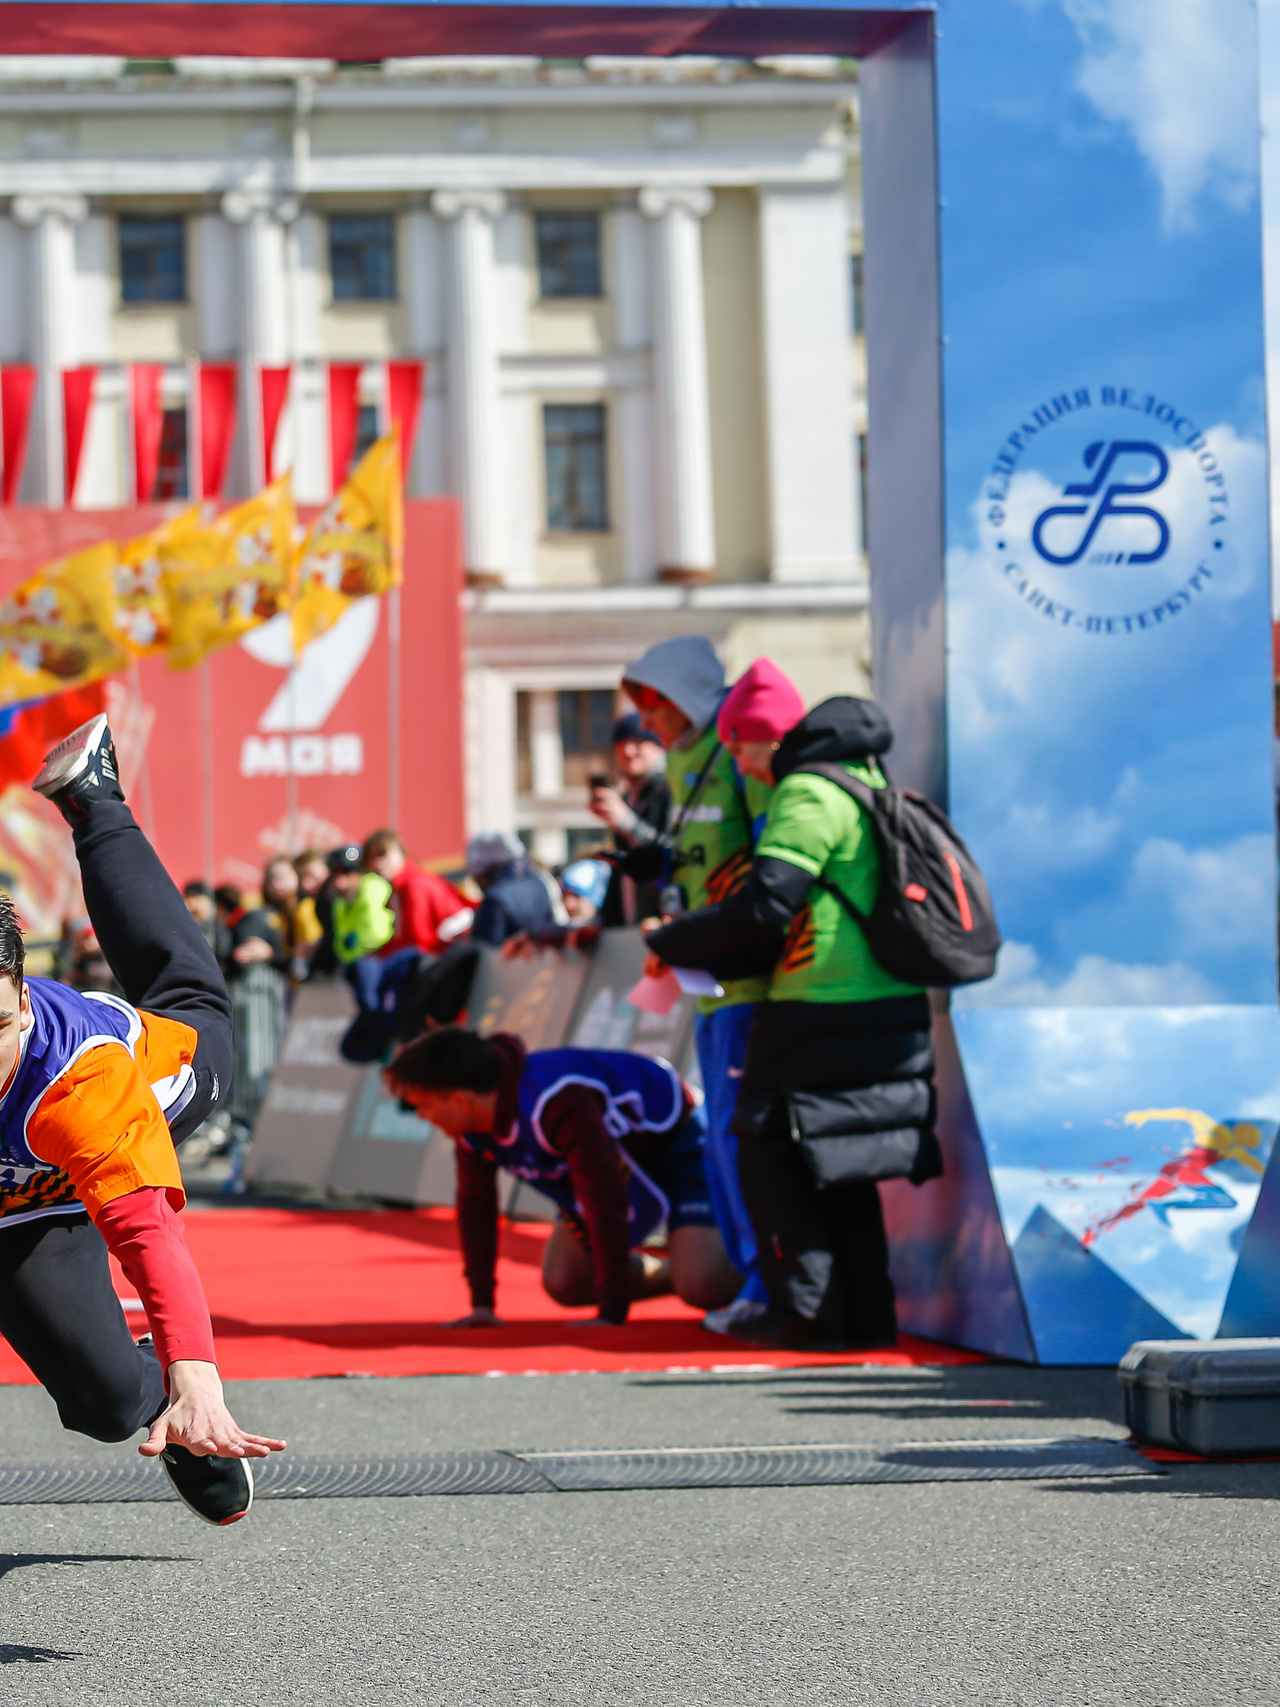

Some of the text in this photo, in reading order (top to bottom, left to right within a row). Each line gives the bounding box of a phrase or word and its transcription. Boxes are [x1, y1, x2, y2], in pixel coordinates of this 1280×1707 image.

[987, 385, 1228, 527] ФЕДЕРАЦИЯ ВЕЛОСПОРТА
[1004, 561, 1213, 635] САНКТ-ПЕТЕРБУРГ
